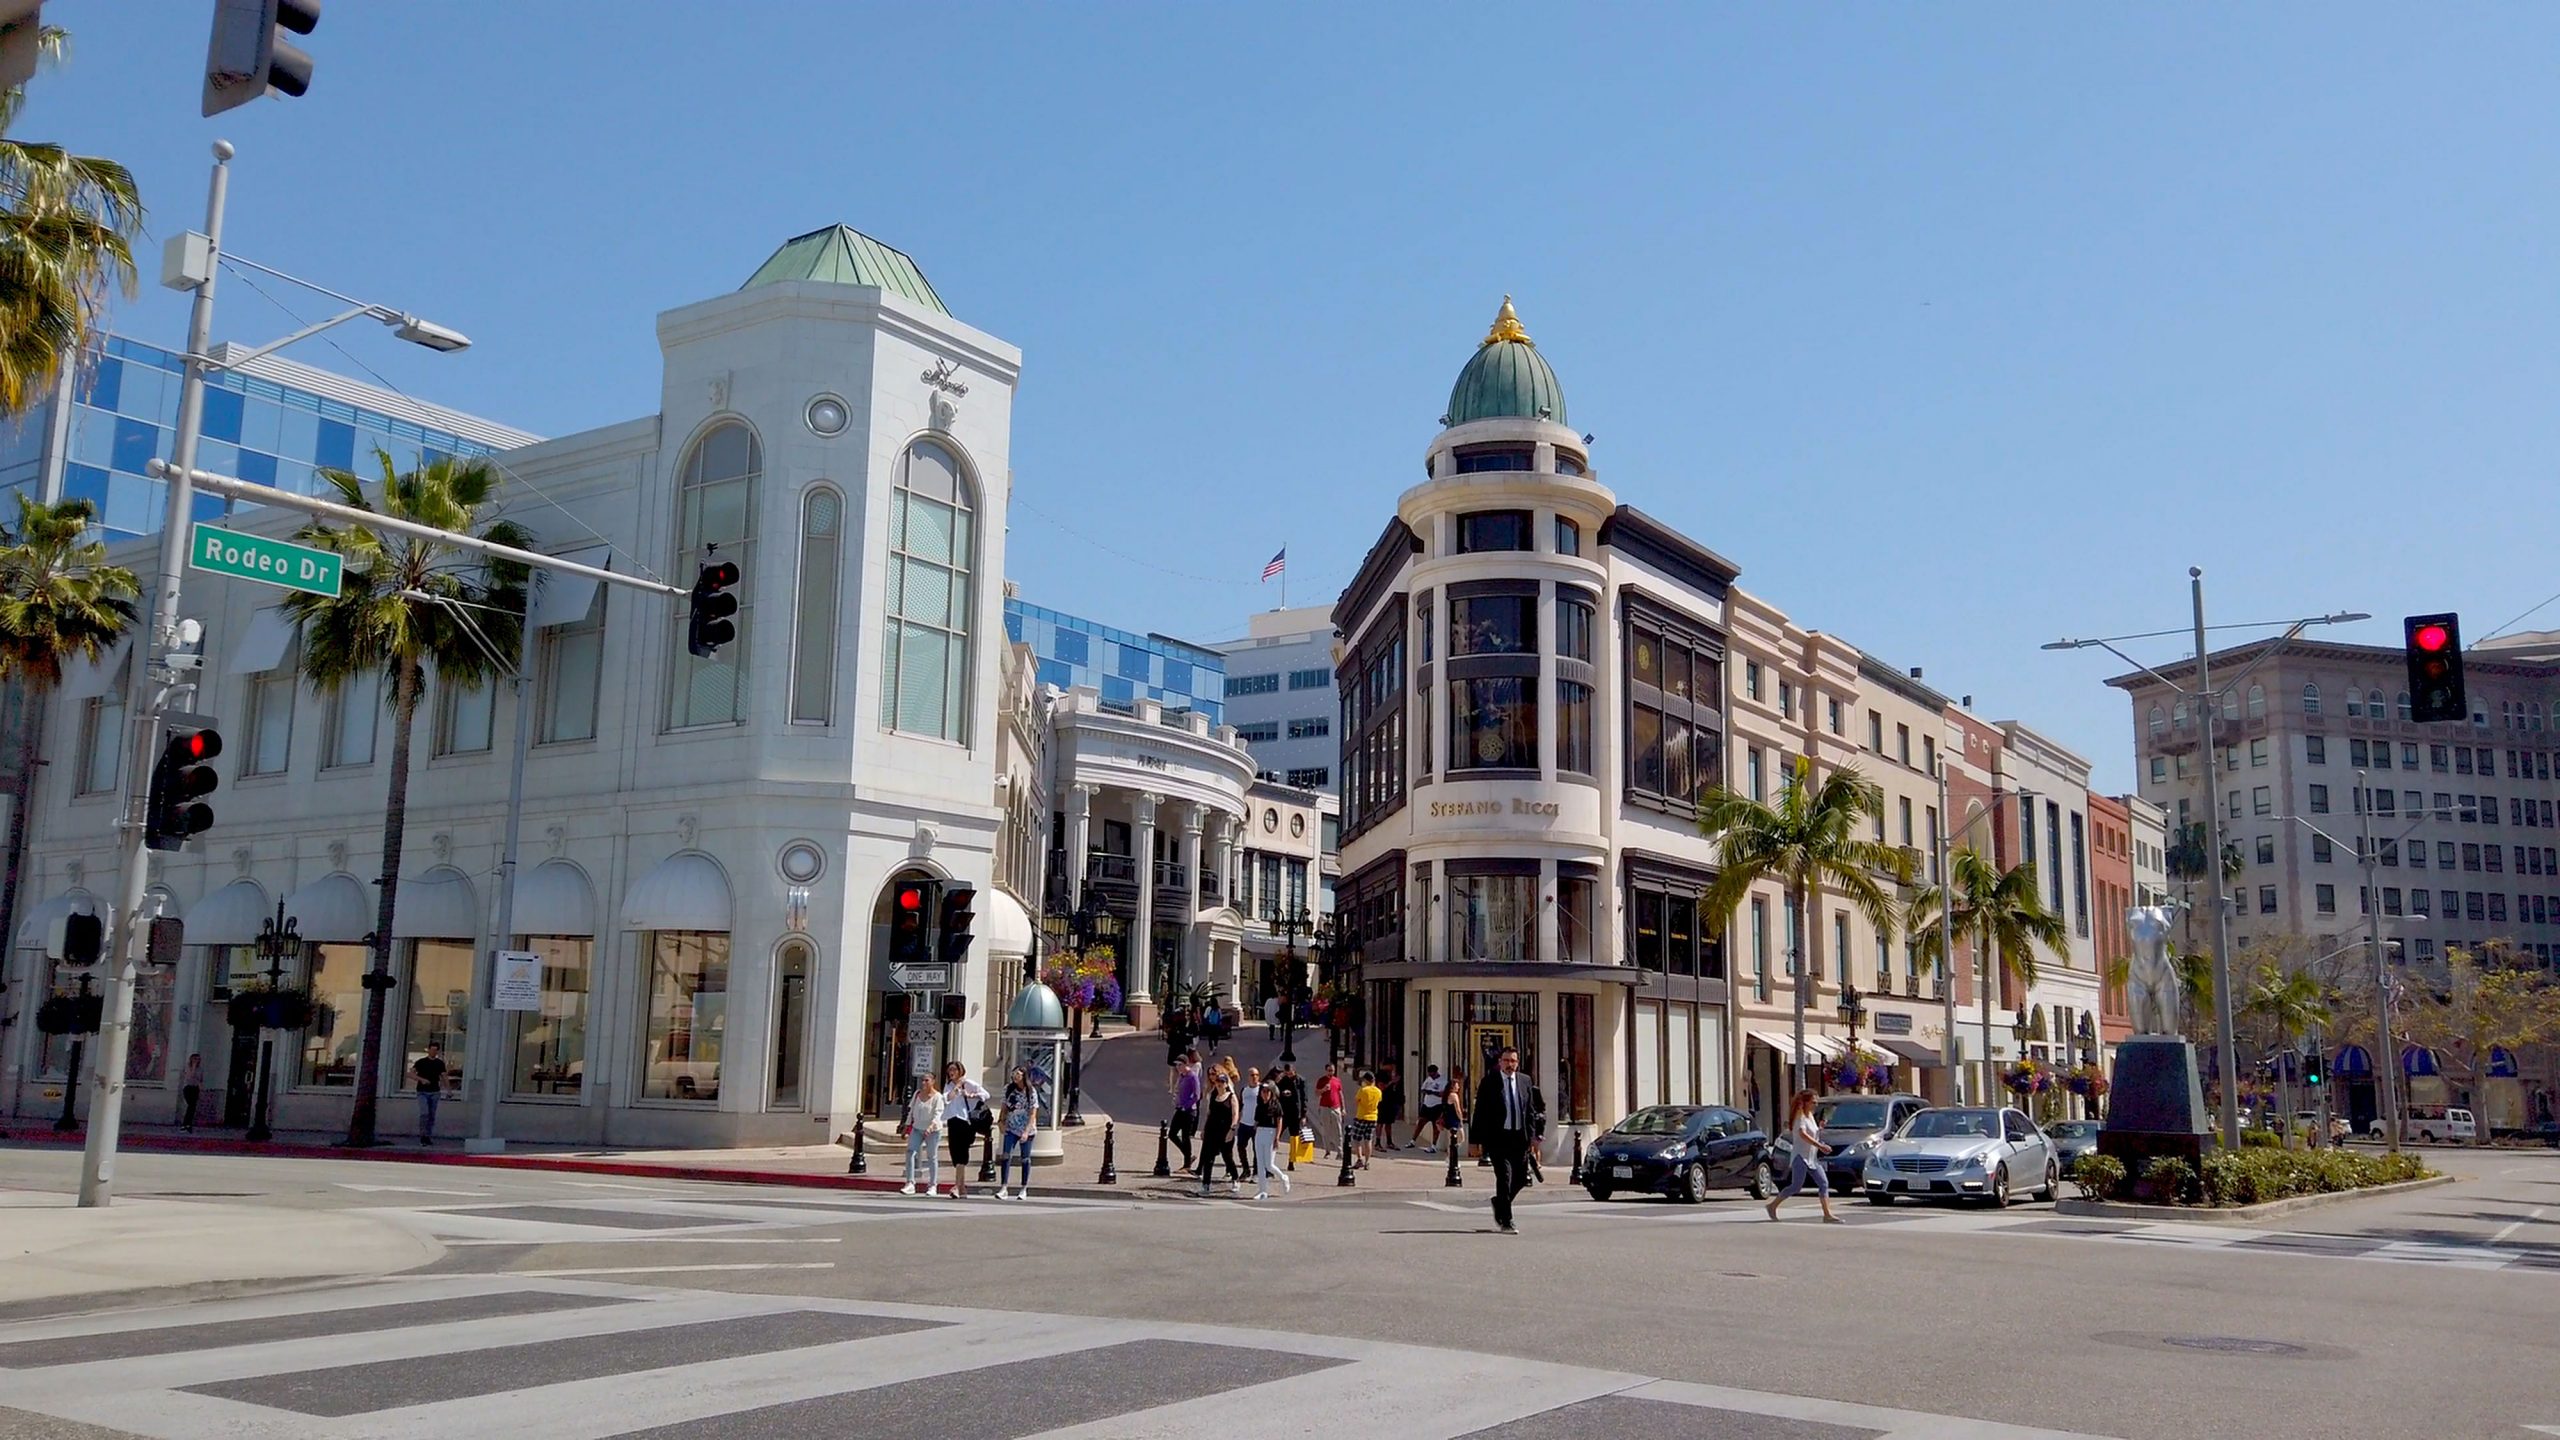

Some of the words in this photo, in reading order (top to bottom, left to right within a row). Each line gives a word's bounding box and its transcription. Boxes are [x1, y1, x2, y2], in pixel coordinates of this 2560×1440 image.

[205, 537, 289, 575] Rodeo
[299, 557, 329, 583] Dr
[907, 972, 924, 982] ONE
[926, 972, 942, 982] WAY
[910, 1030, 921, 1040] OK
